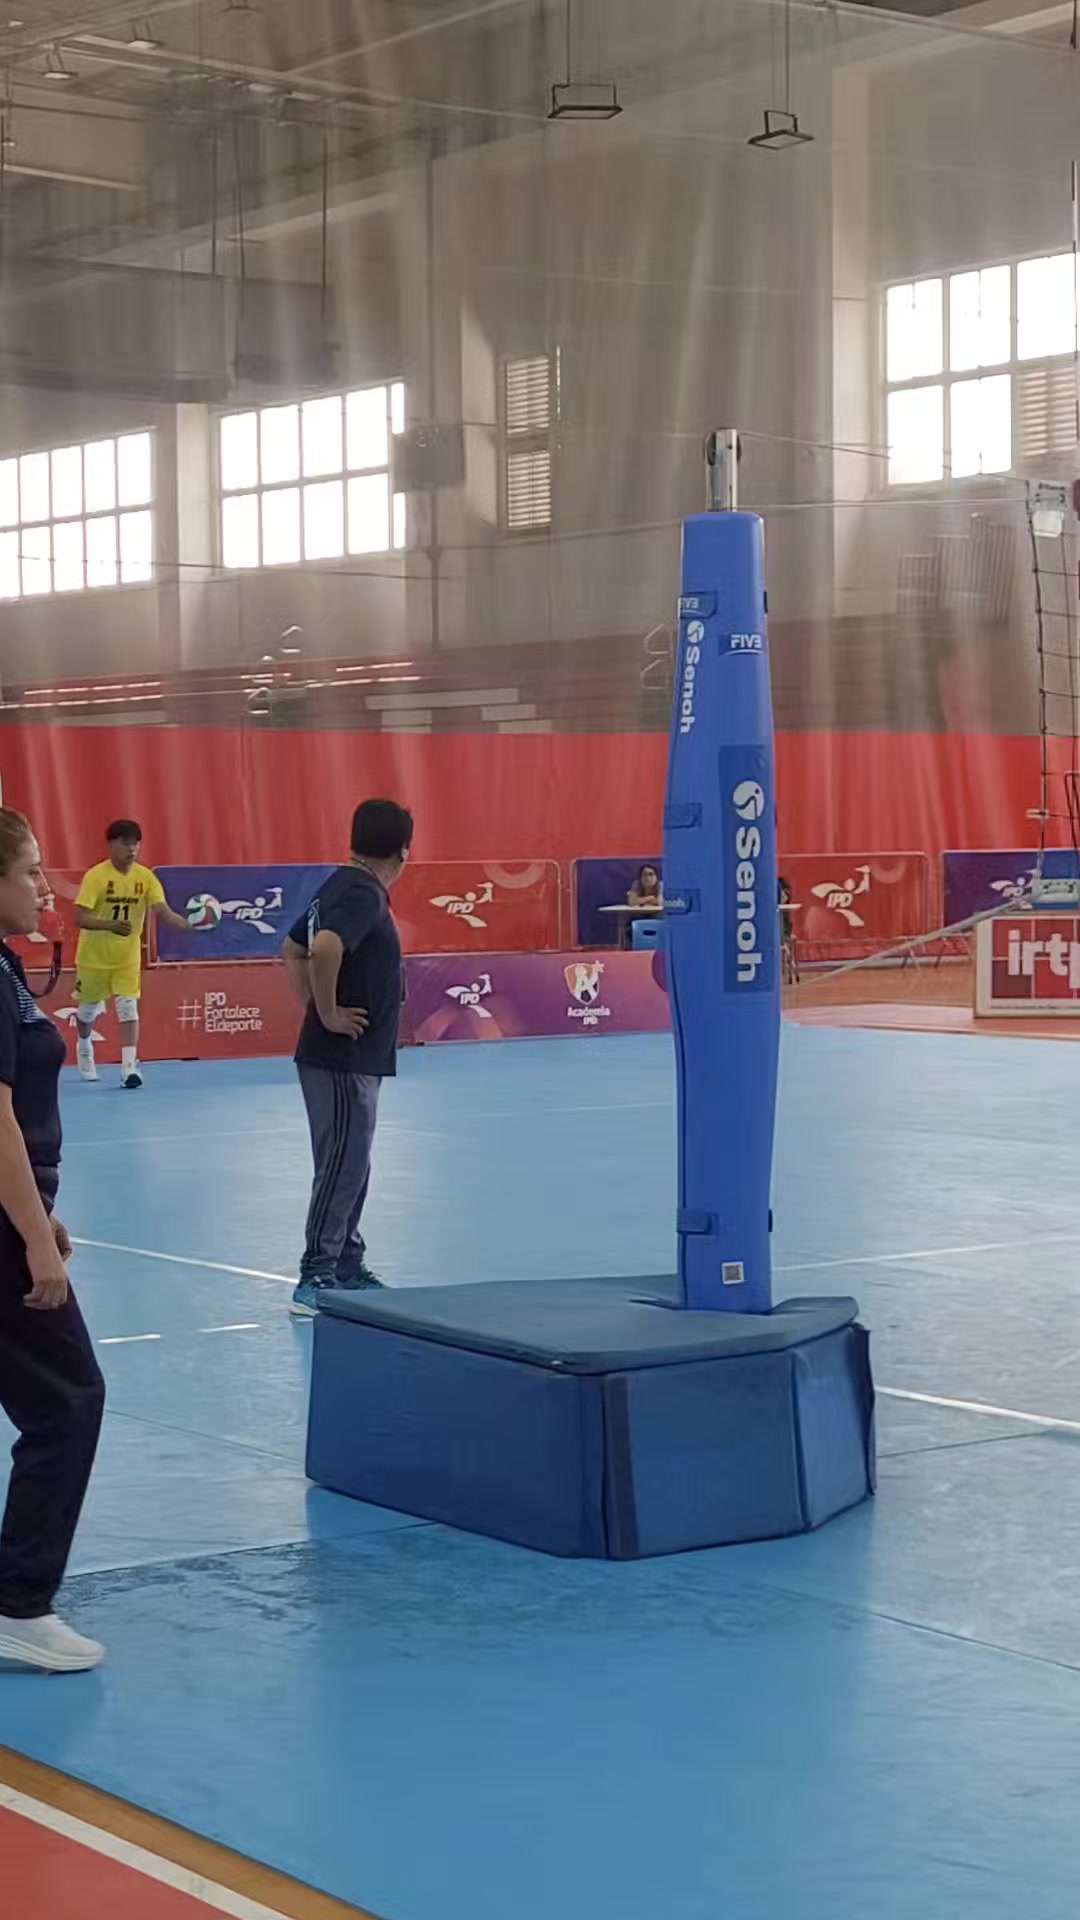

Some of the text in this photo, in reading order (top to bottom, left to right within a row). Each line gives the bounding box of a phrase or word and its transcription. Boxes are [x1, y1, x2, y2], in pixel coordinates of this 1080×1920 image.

[680, 646, 700, 733] Senoh
[1002, 886, 1024, 897] IPD
[735, 826, 763, 982] Senoh
[827, 892, 852, 908] IPD
[112, 905, 129, 920] 11
[235, 907, 264, 920] IPD
[447, 902, 474, 914] IPD
[205, 992, 226, 1006] IPD
[460, 993, 480, 1005] IPD
[205, 1004, 260, 1019] Fortalece
[567, 1006, 610, 1017] Academia
